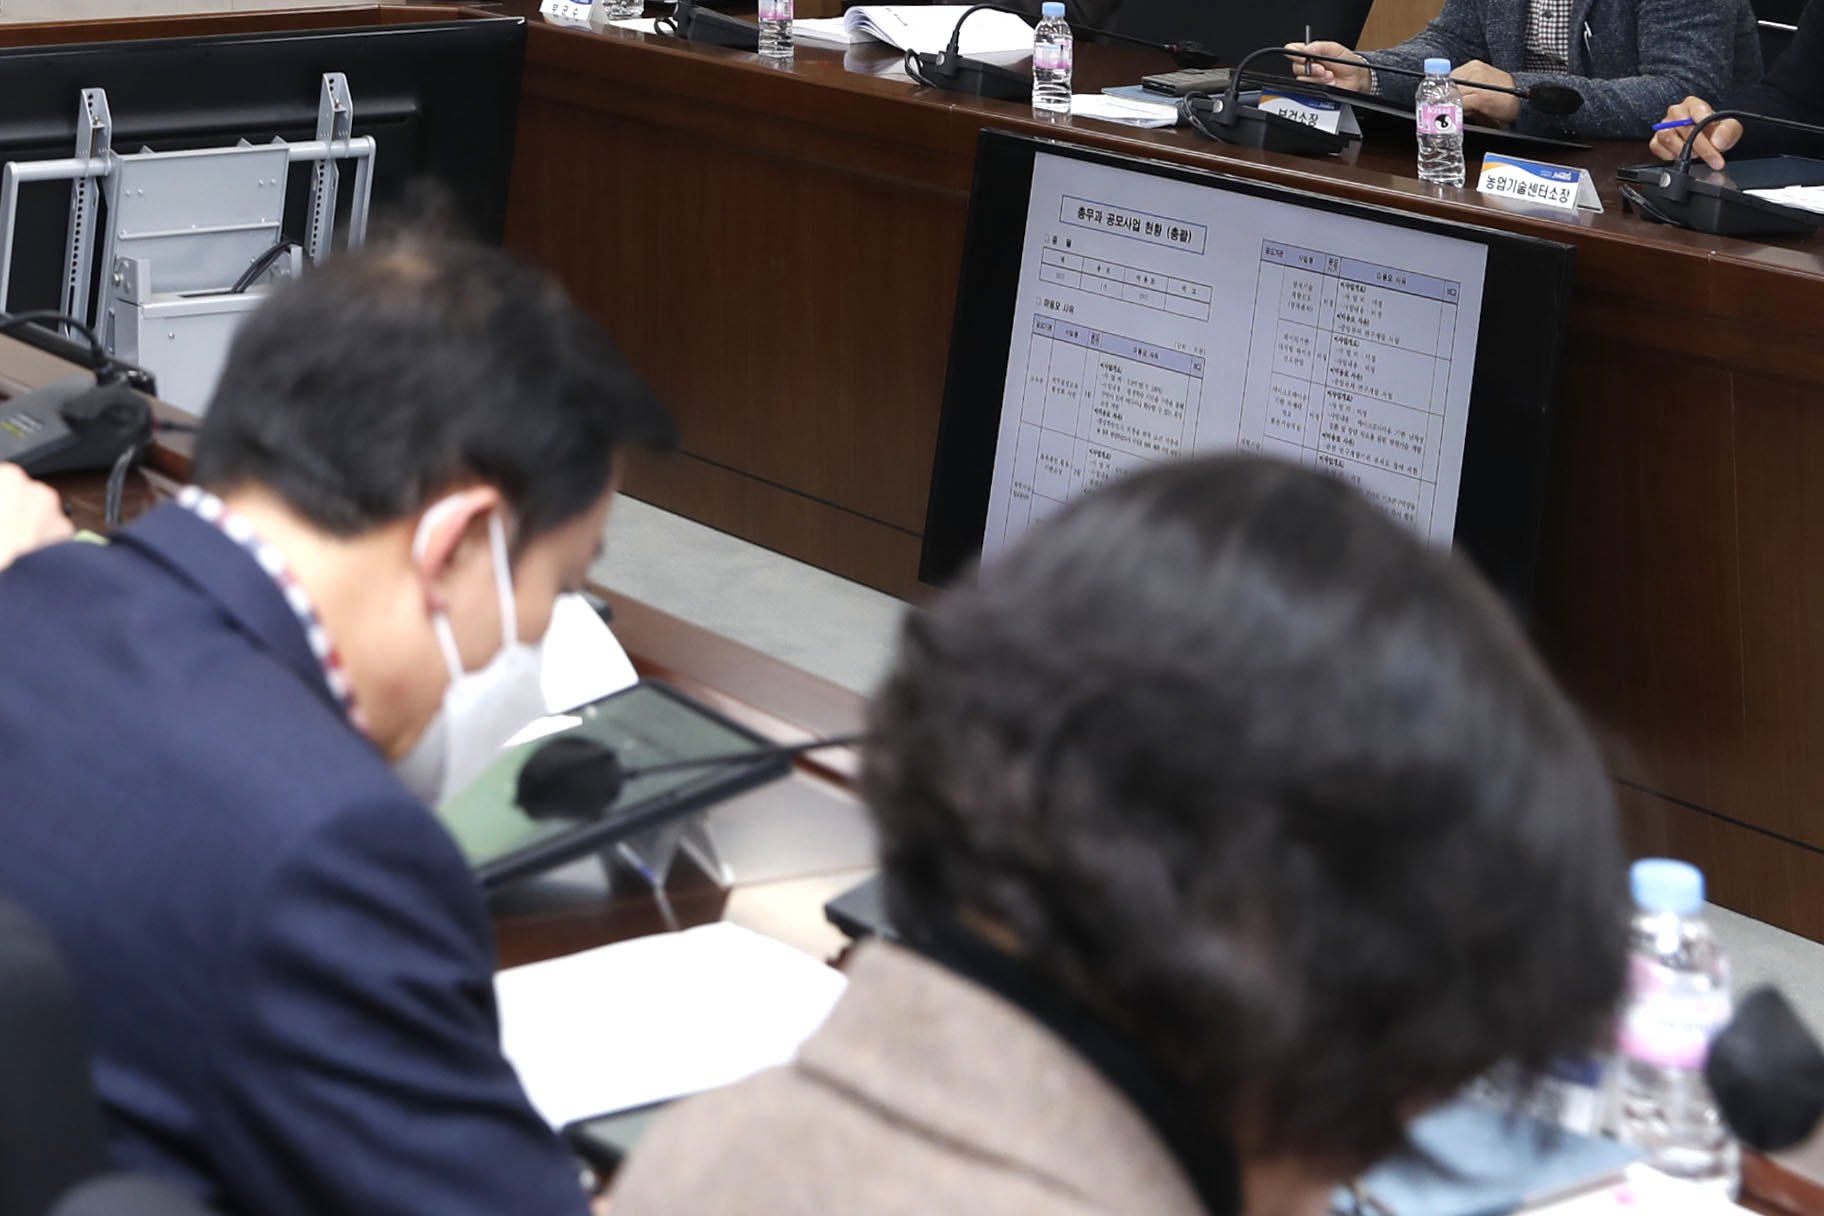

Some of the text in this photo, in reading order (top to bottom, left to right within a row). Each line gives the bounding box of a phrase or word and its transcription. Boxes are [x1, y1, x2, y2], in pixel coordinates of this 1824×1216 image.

[1485, 174, 1571, 204] 농업기술센터소장
[1077, 205, 1103, 224] 총무과
[1106, 212, 1141, 233] 공모사업
